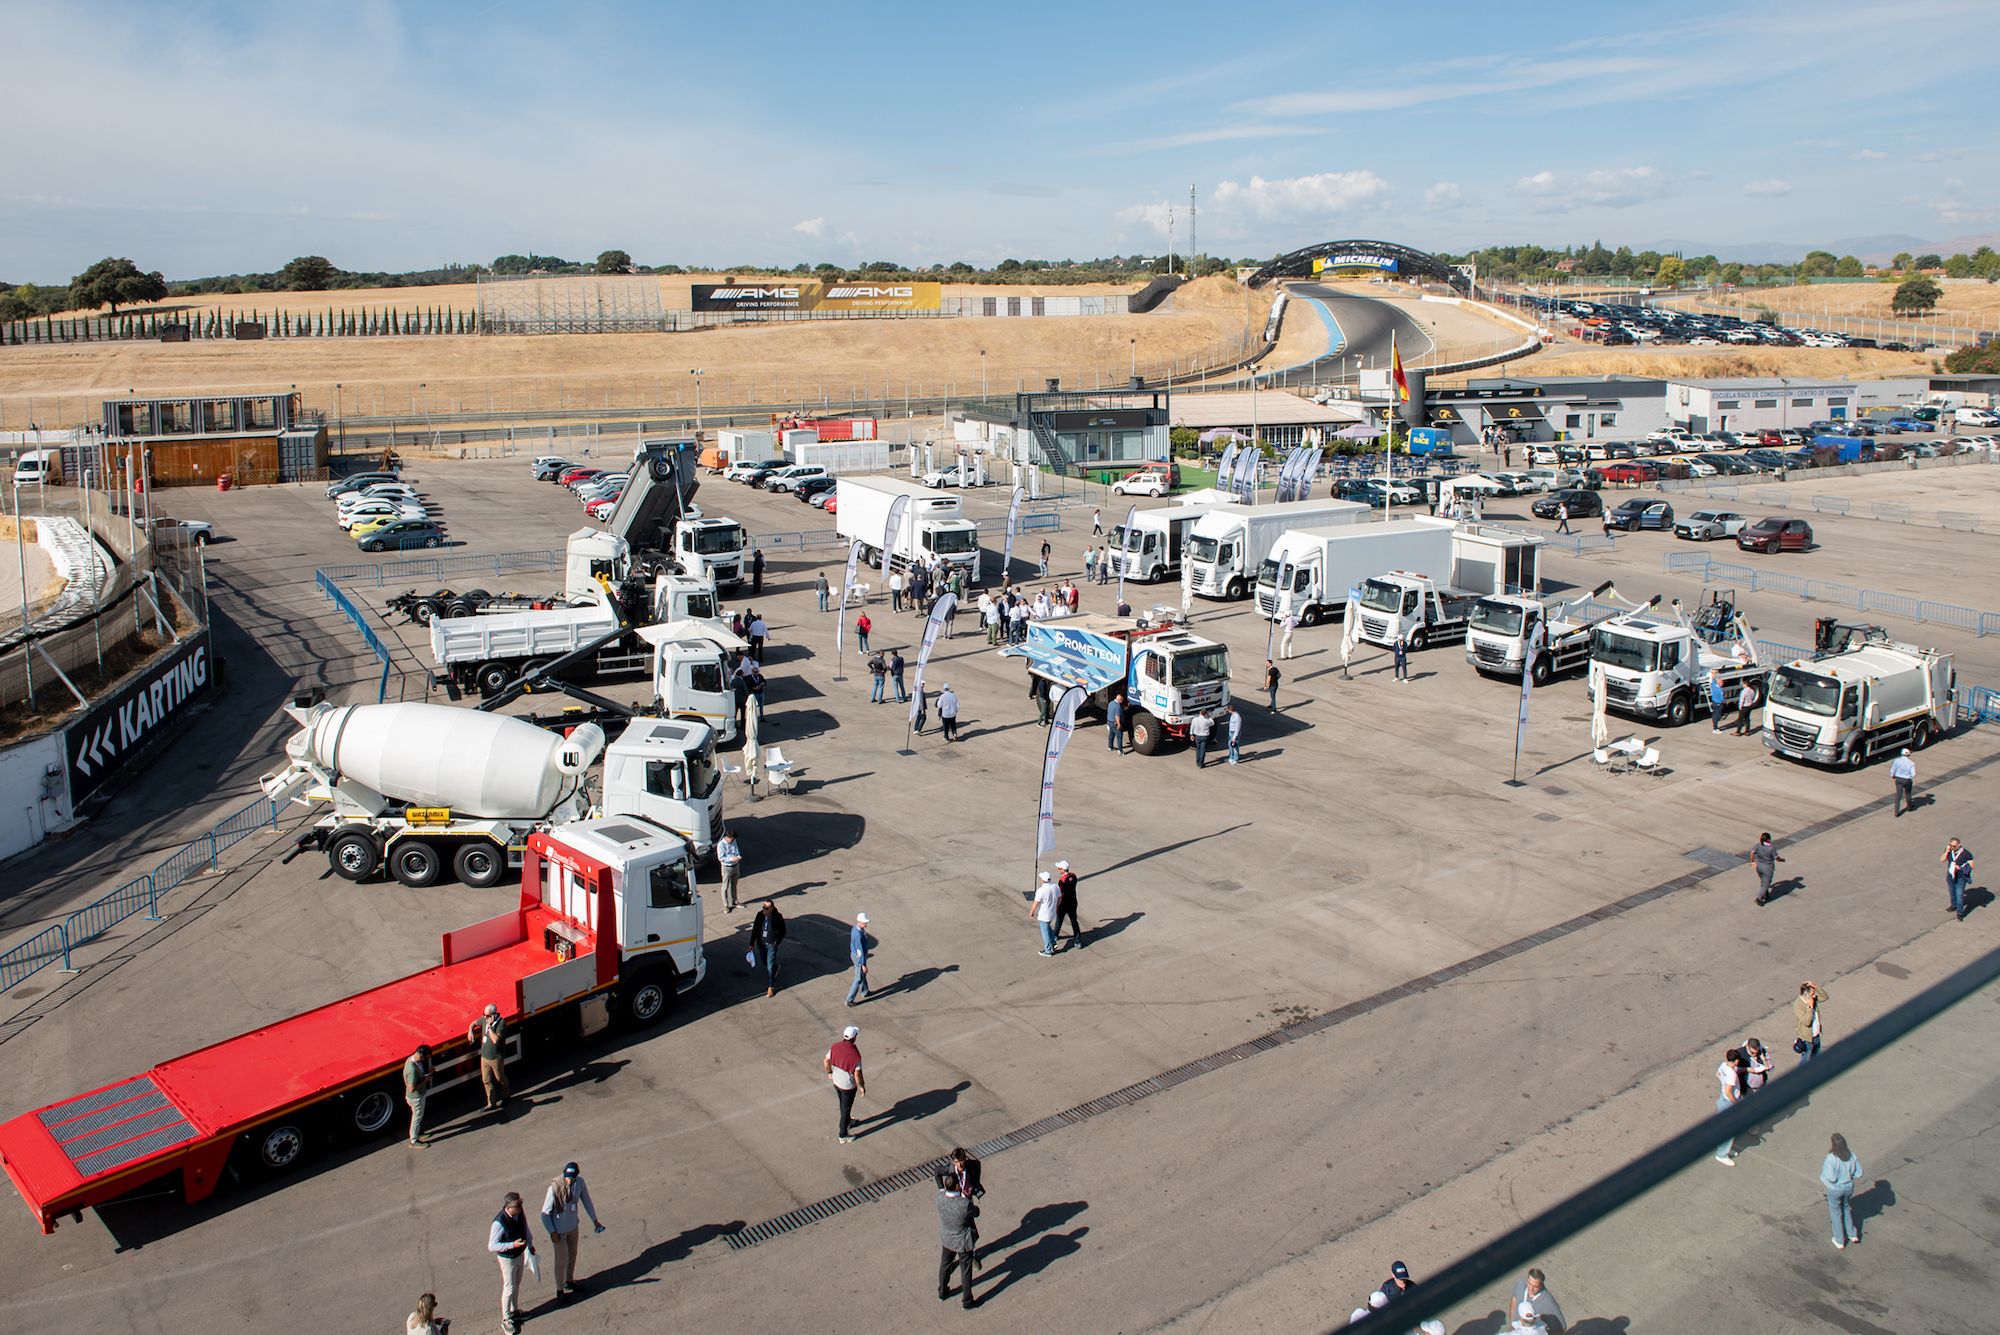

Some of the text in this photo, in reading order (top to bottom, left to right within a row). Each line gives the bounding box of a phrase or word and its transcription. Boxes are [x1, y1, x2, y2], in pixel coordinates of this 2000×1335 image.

[1334, 255, 1394, 267] MICHELIN
[737, 287, 800, 299] AMG
[852, 286, 913, 298] AMG
[1712, 391, 1737, 399] ESCUELA
[1055, 631, 1121, 665] PROMETEON
[118, 646, 207, 750] KARTING
